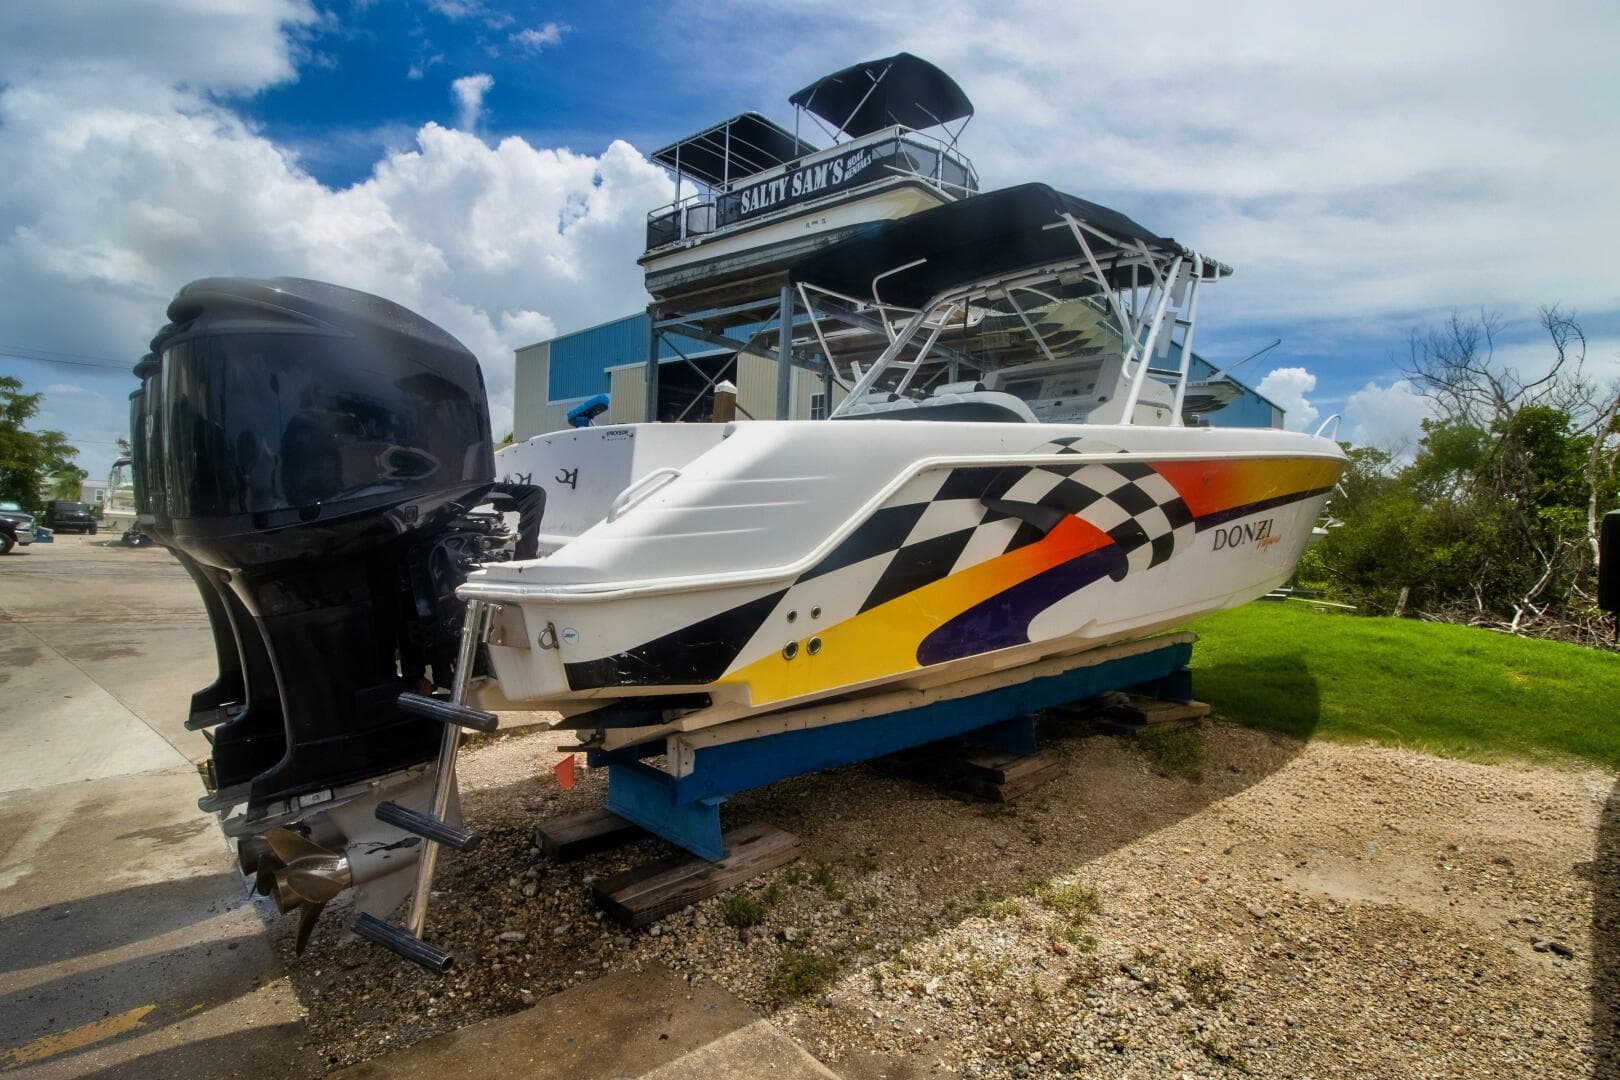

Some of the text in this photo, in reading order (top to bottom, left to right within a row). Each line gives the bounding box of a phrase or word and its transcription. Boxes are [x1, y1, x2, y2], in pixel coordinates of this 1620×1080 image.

[845, 155, 871, 181] RENTALS
[741, 159, 844, 214] SALTY SAM'S
[1213, 519, 1274, 551] DONZI
